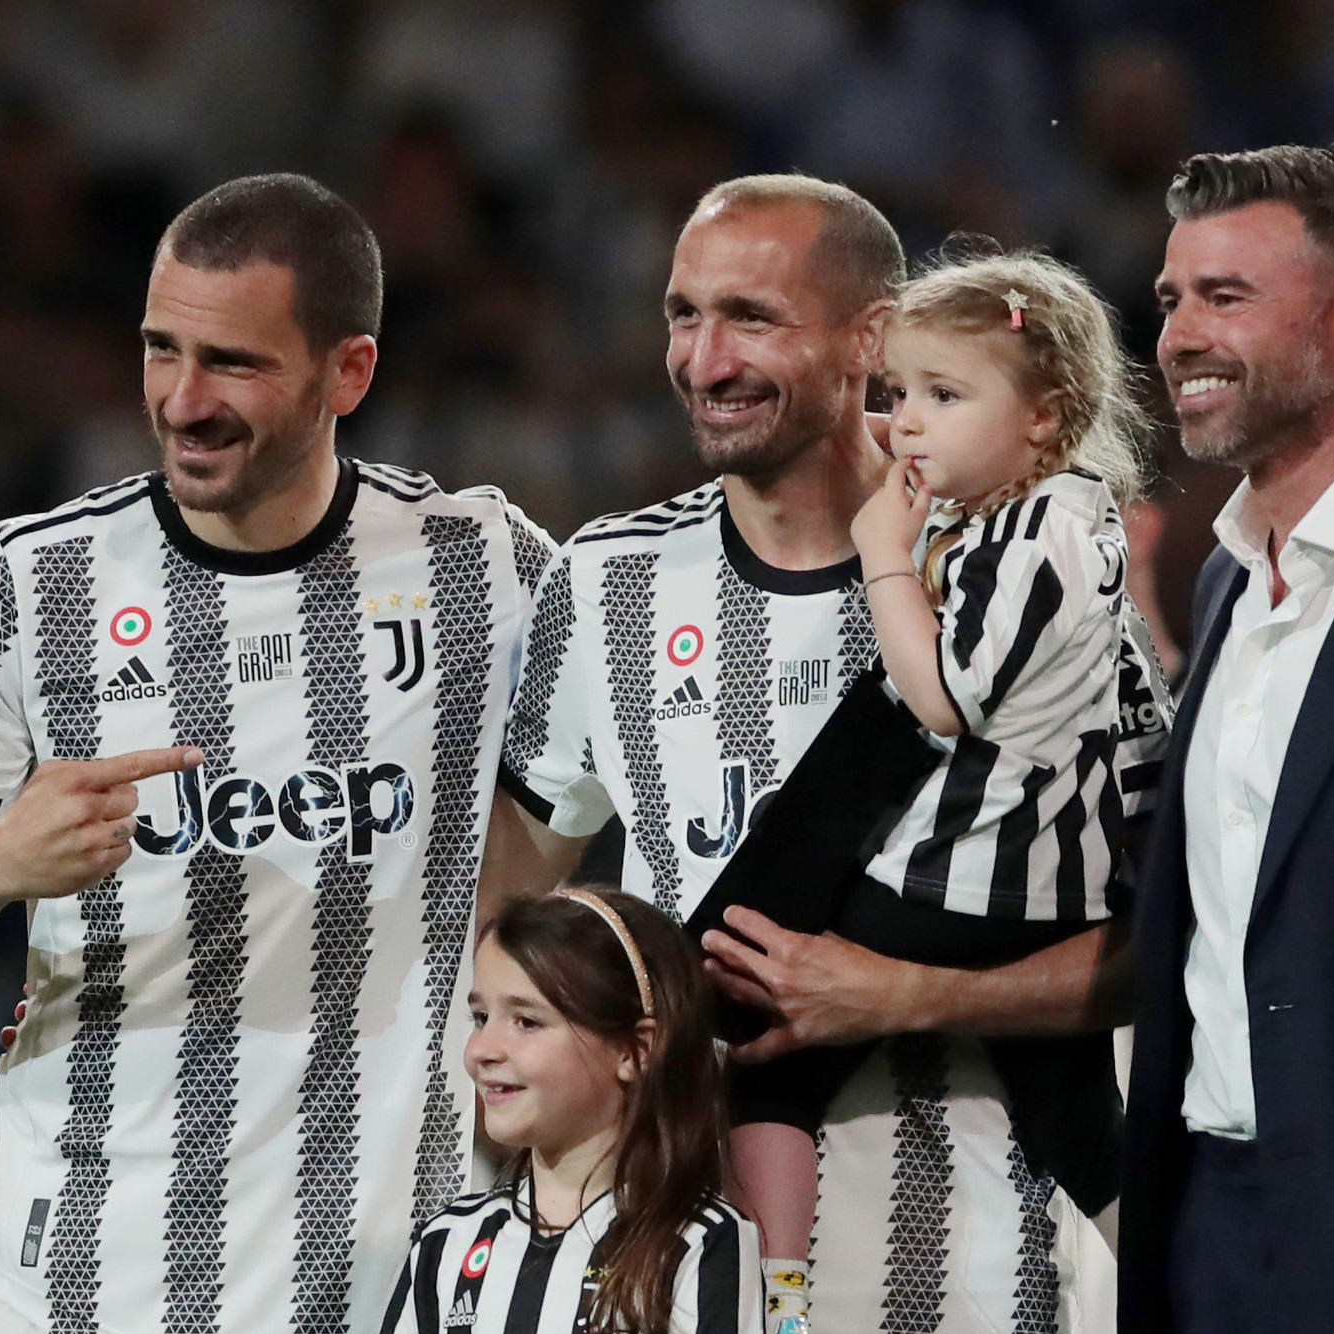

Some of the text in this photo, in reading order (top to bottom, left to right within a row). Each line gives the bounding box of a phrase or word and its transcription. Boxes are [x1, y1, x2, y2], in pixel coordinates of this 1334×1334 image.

[236, 636, 259, 651] THE
[779, 660, 799, 675] THE
[101, 684, 168, 702] adidas
[656, 701, 712, 721] adidas
[134, 761, 417, 859] Jeep
[443, 1312, 478, 1330] adidas
